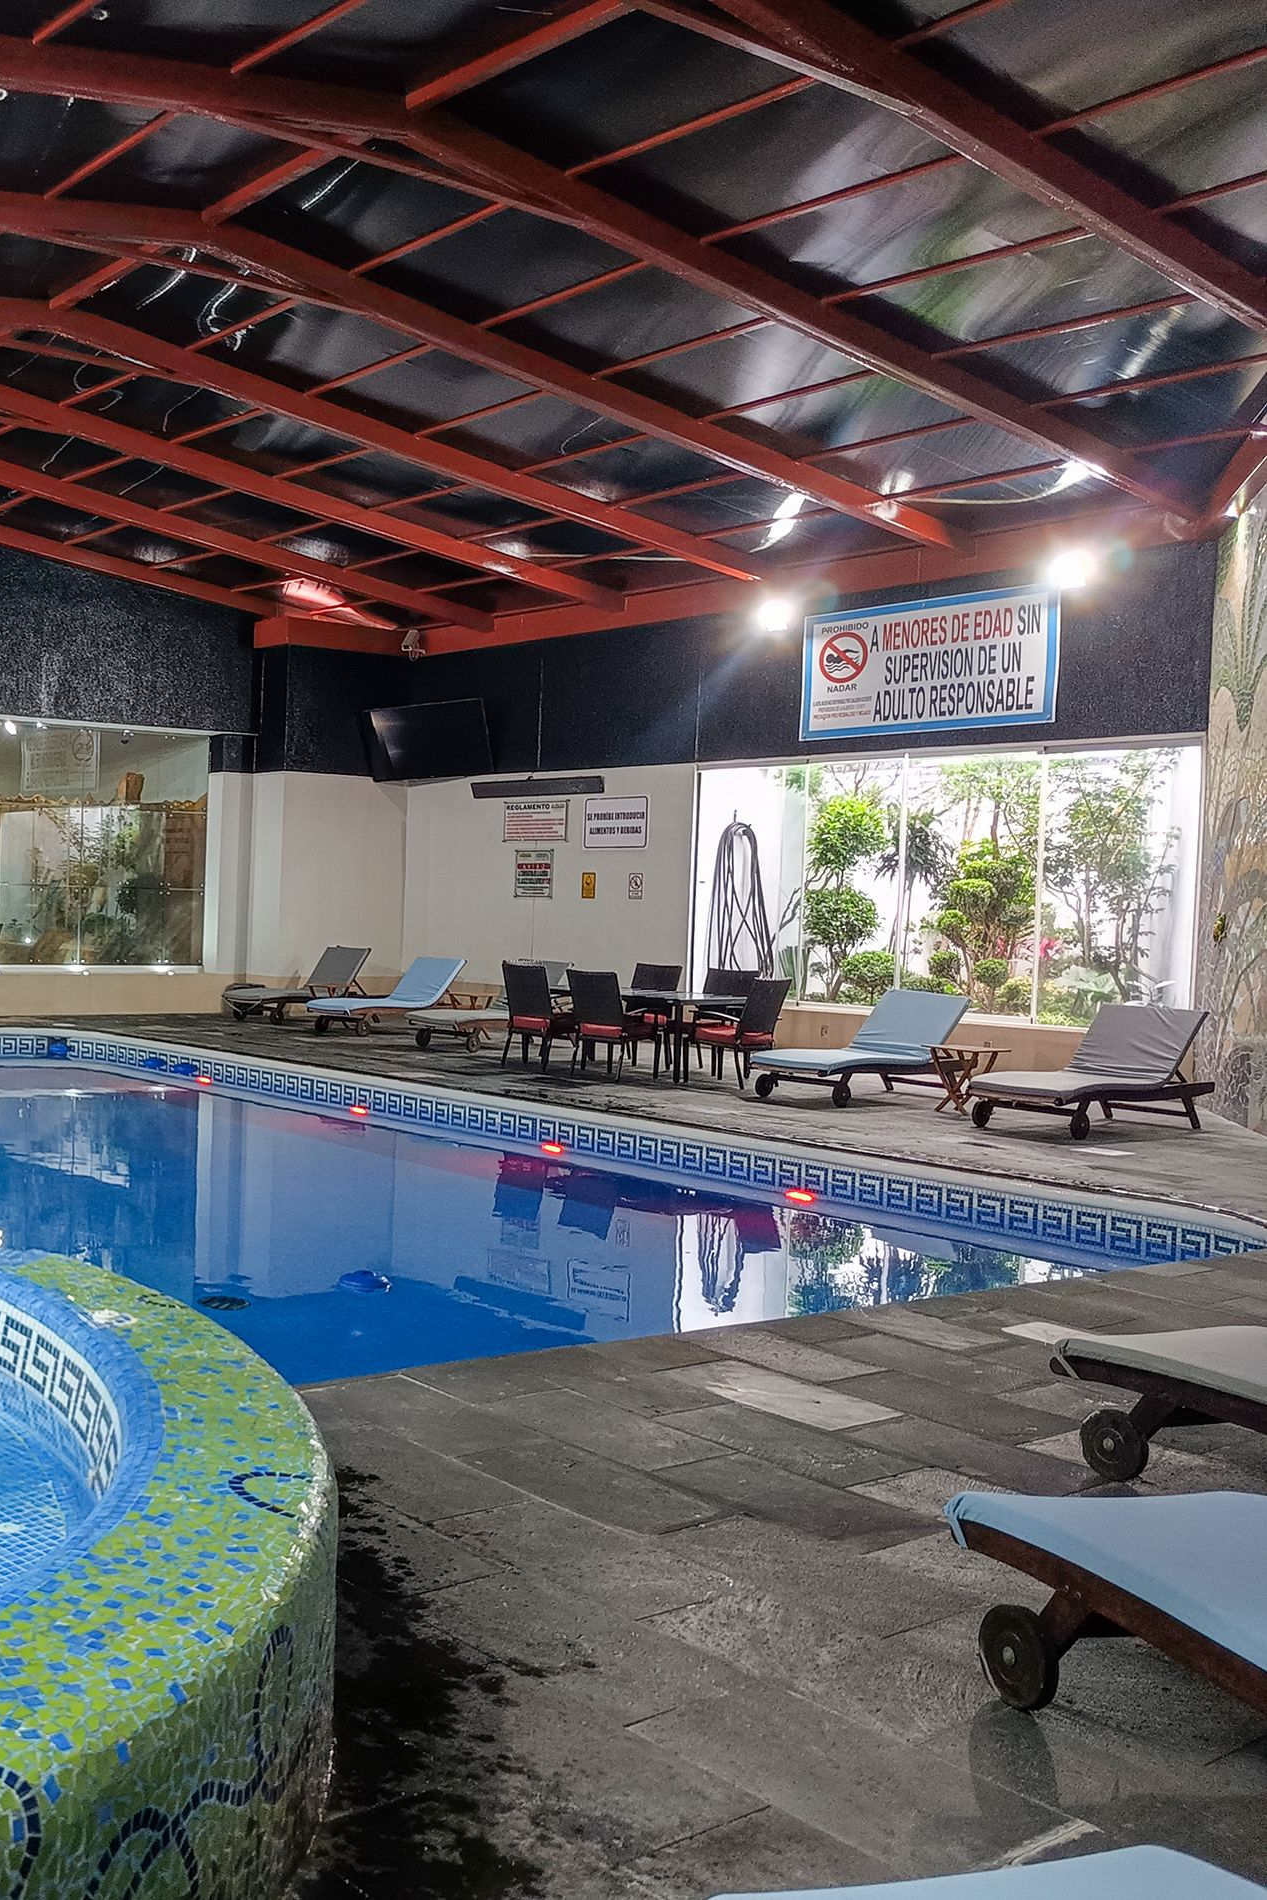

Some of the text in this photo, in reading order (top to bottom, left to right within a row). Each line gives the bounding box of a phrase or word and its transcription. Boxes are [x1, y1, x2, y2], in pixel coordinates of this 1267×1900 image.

[821, 621, 869, 635] PROHIBIDO
[870, 603, 1042, 653] A MENORES DE EDAD SIN
[885, 642, 1022, 685] SUPERVISION DE UN
[827, 683, 858, 694] NADAR
[873, 676, 1035, 722] ADULTO RESPONSABLE
[587, 812, 593, 821] SE
[589, 826, 616, 835] ALIMENTOS
[620, 826, 642, 835] BEBIDAS
